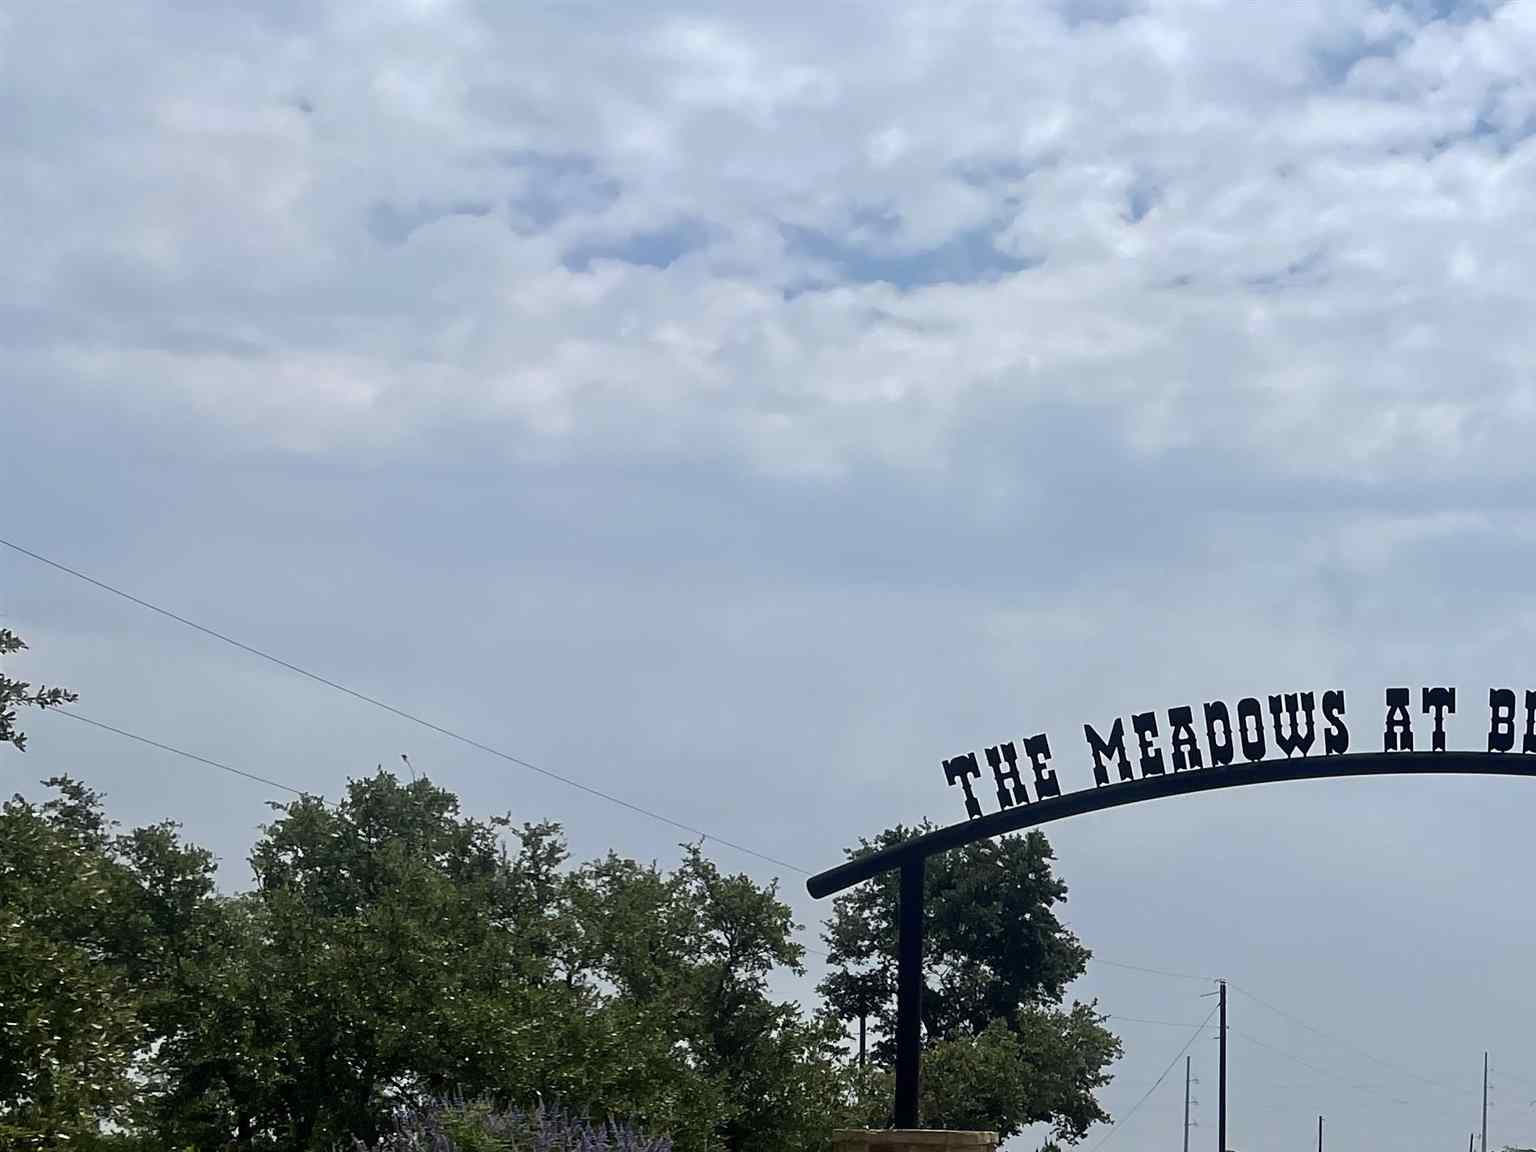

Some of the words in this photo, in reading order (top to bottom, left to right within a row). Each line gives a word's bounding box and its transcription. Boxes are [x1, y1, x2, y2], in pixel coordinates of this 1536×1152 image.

[942, 733, 1061, 821] THE
[1083, 690, 1350, 788] MEADOWS
[1384, 687, 1456, 752] AT
